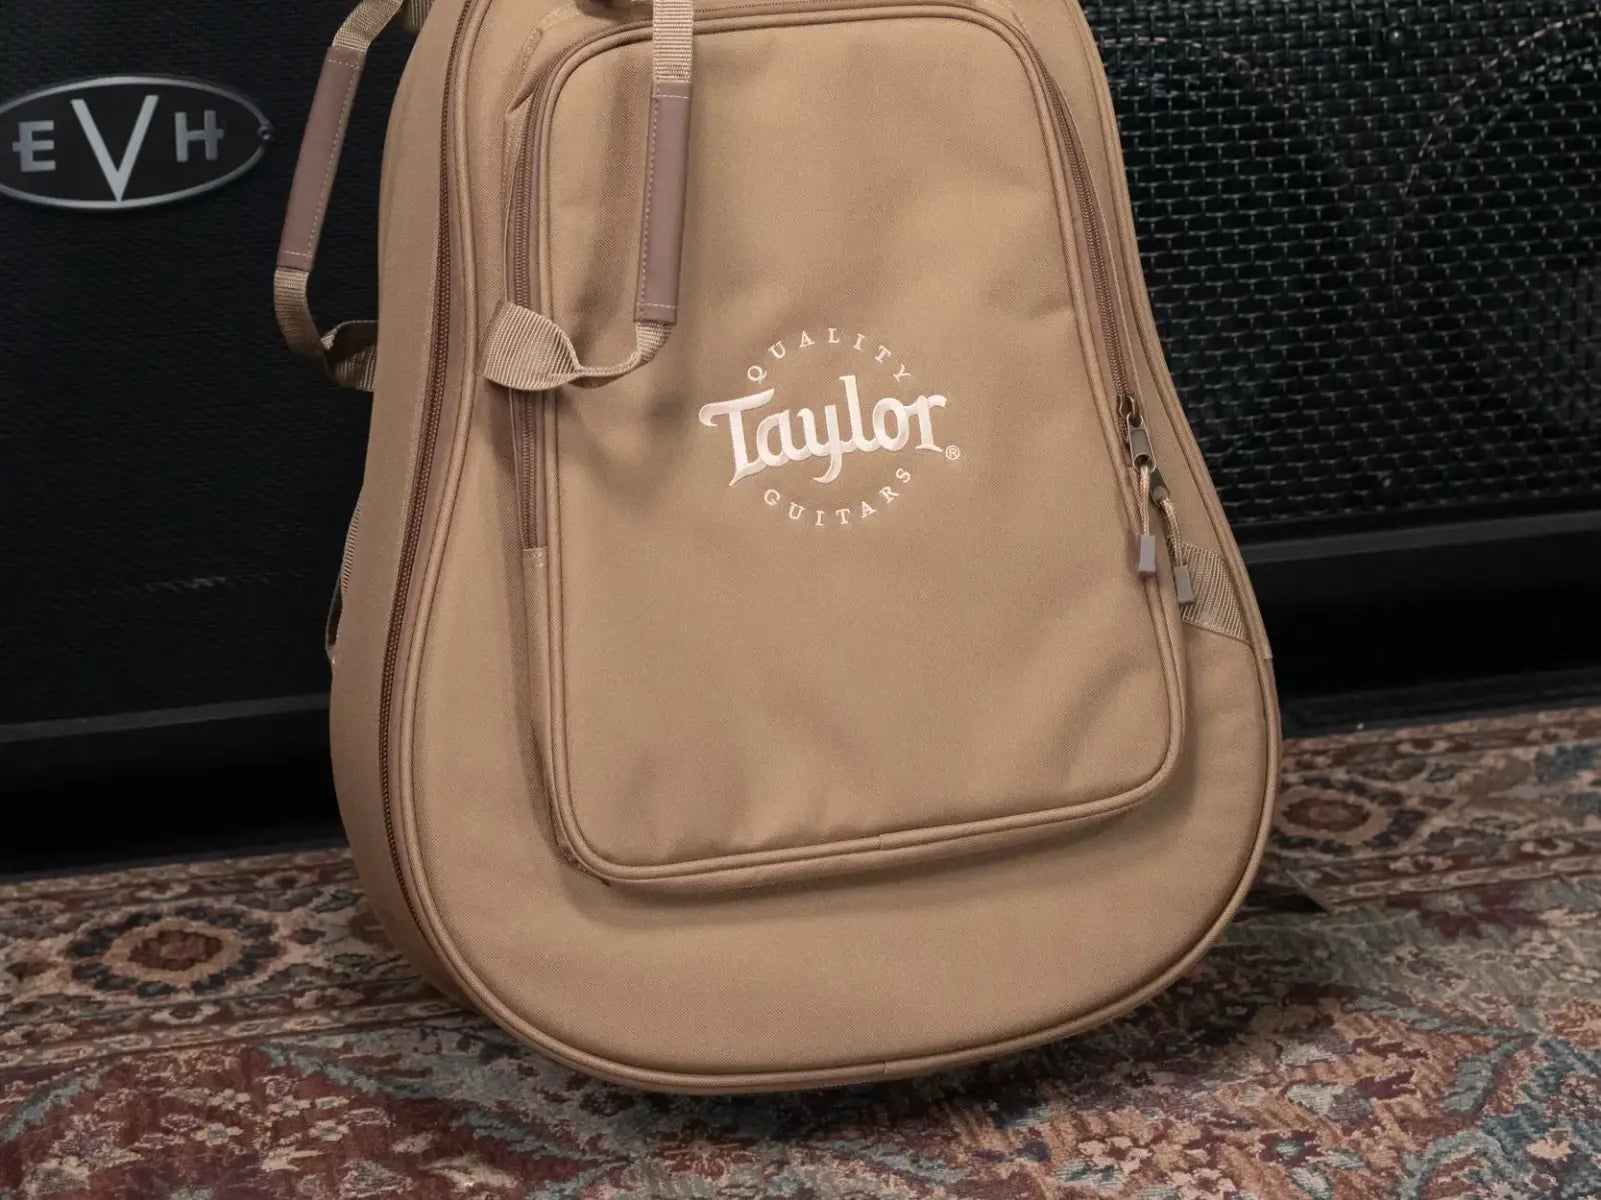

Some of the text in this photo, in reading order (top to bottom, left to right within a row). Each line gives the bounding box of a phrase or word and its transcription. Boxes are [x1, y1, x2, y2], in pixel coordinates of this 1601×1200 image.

[12, 95, 225, 202] EVH
[747, 328, 912, 384] QUALITY
[698, 374, 948, 487] Taylor
[763, 467, 912, 527] GUITARS
